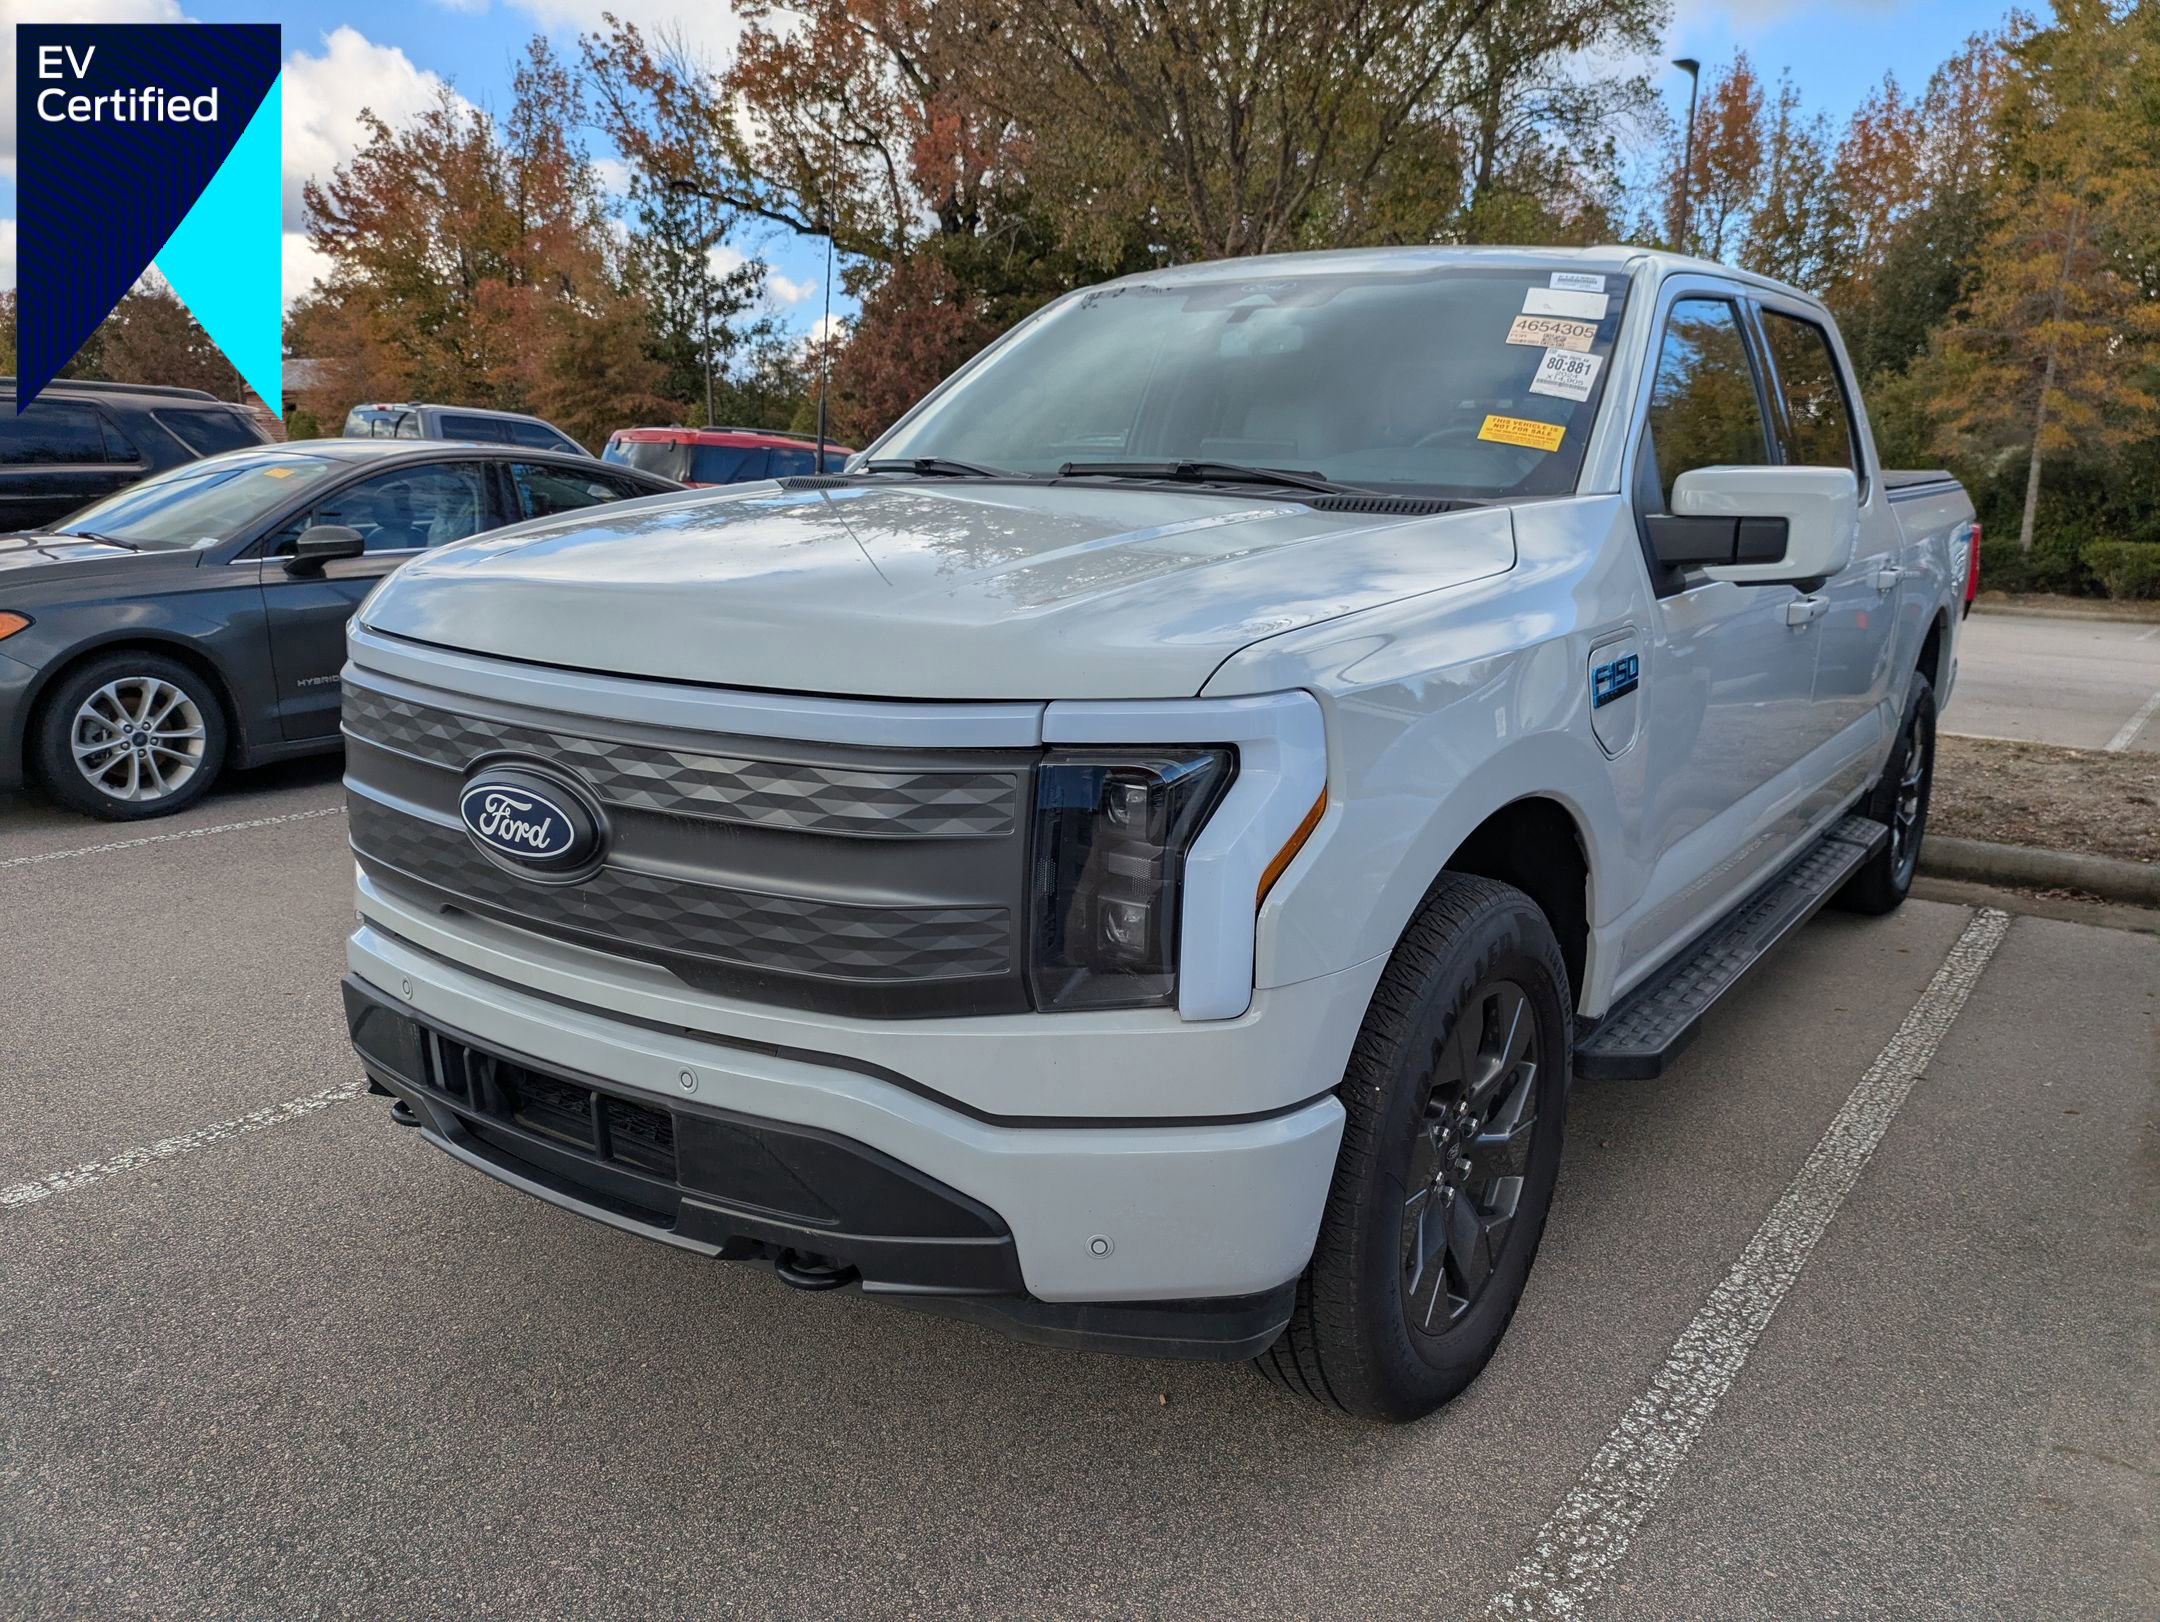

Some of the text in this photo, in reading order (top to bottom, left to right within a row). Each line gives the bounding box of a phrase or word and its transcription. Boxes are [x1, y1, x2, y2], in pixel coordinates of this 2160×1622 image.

[1516, 320, 1595, 339] 4654305
[297, 674, 340, 687] HYBRID
[479, 793, 552, 849] Ford
